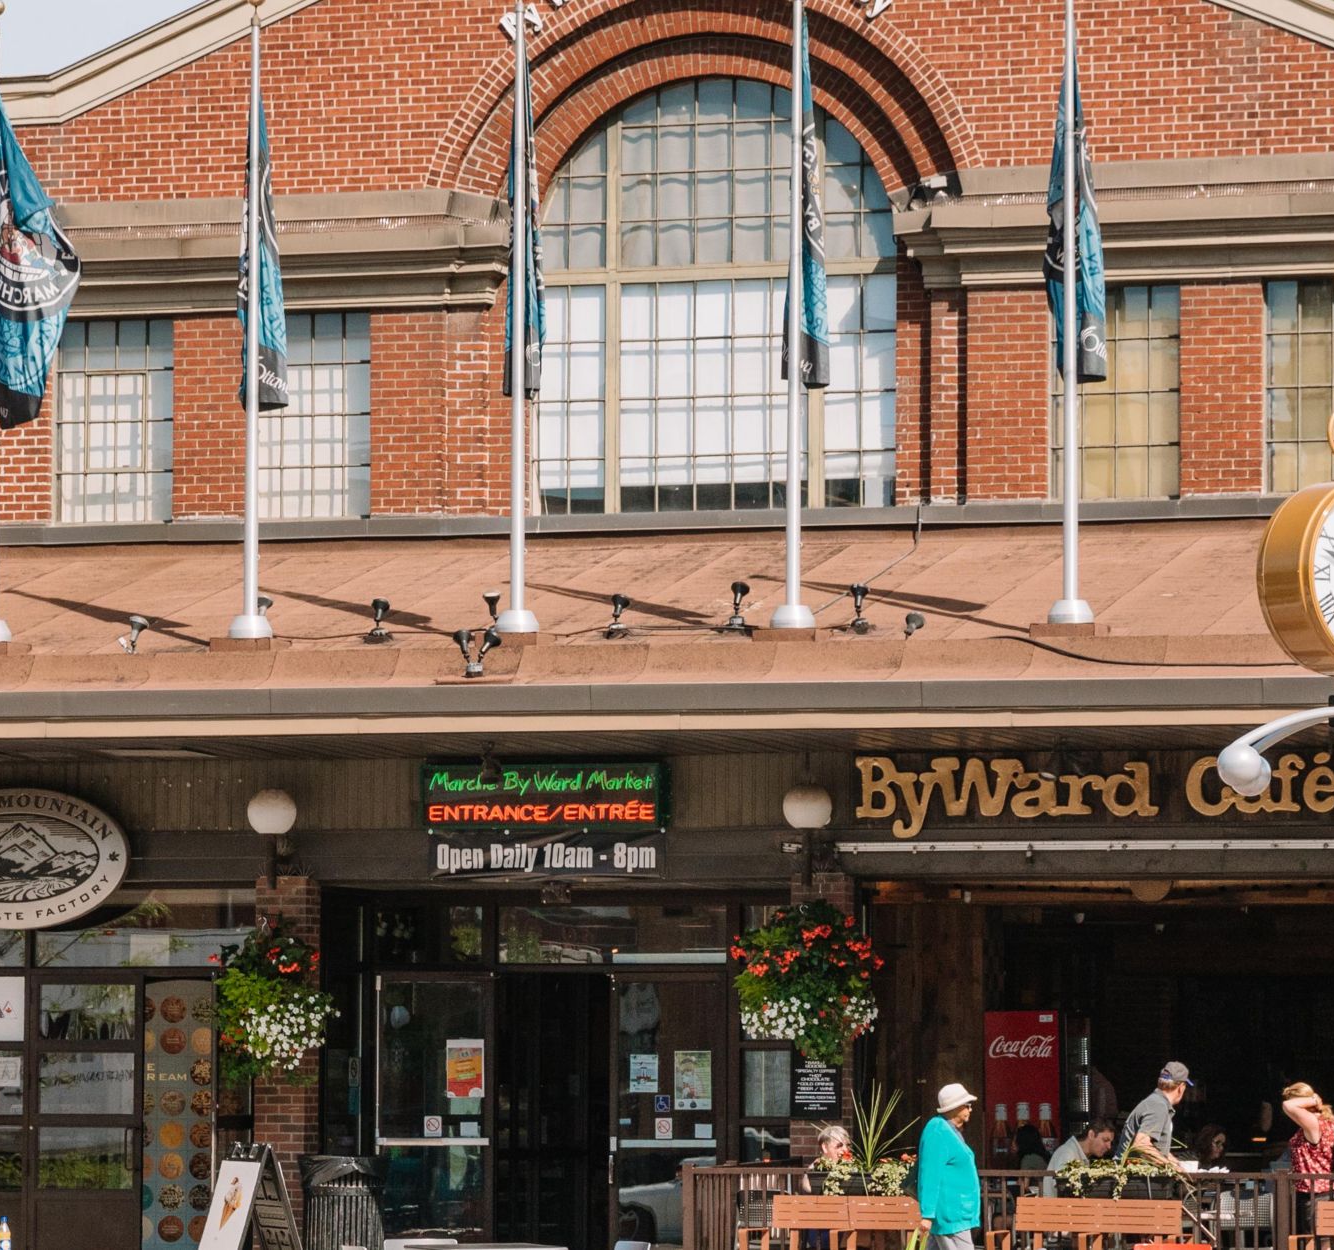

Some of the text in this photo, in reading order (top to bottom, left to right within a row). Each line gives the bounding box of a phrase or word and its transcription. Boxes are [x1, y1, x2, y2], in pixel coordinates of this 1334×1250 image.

[1314, 564, 1331, 582] IX
[503, 771, 531, 796] By
[534, 771, 582, 792] Ward
[585, 771, 653, 792] Market
[855, 756, 1160, 839] ByWard
[429, 800, 655, 821] ENTRANCE/ENTRÉE
[436, 843, 484, 873] Open
[490, 843, 539, 873] Daily
[543, 842, 594, 869] 10am
[613, 842, 656, 873] 8pm
[35, 874, 110, 919] FACTORY
[147, 1072, 188, 1081] REAM
